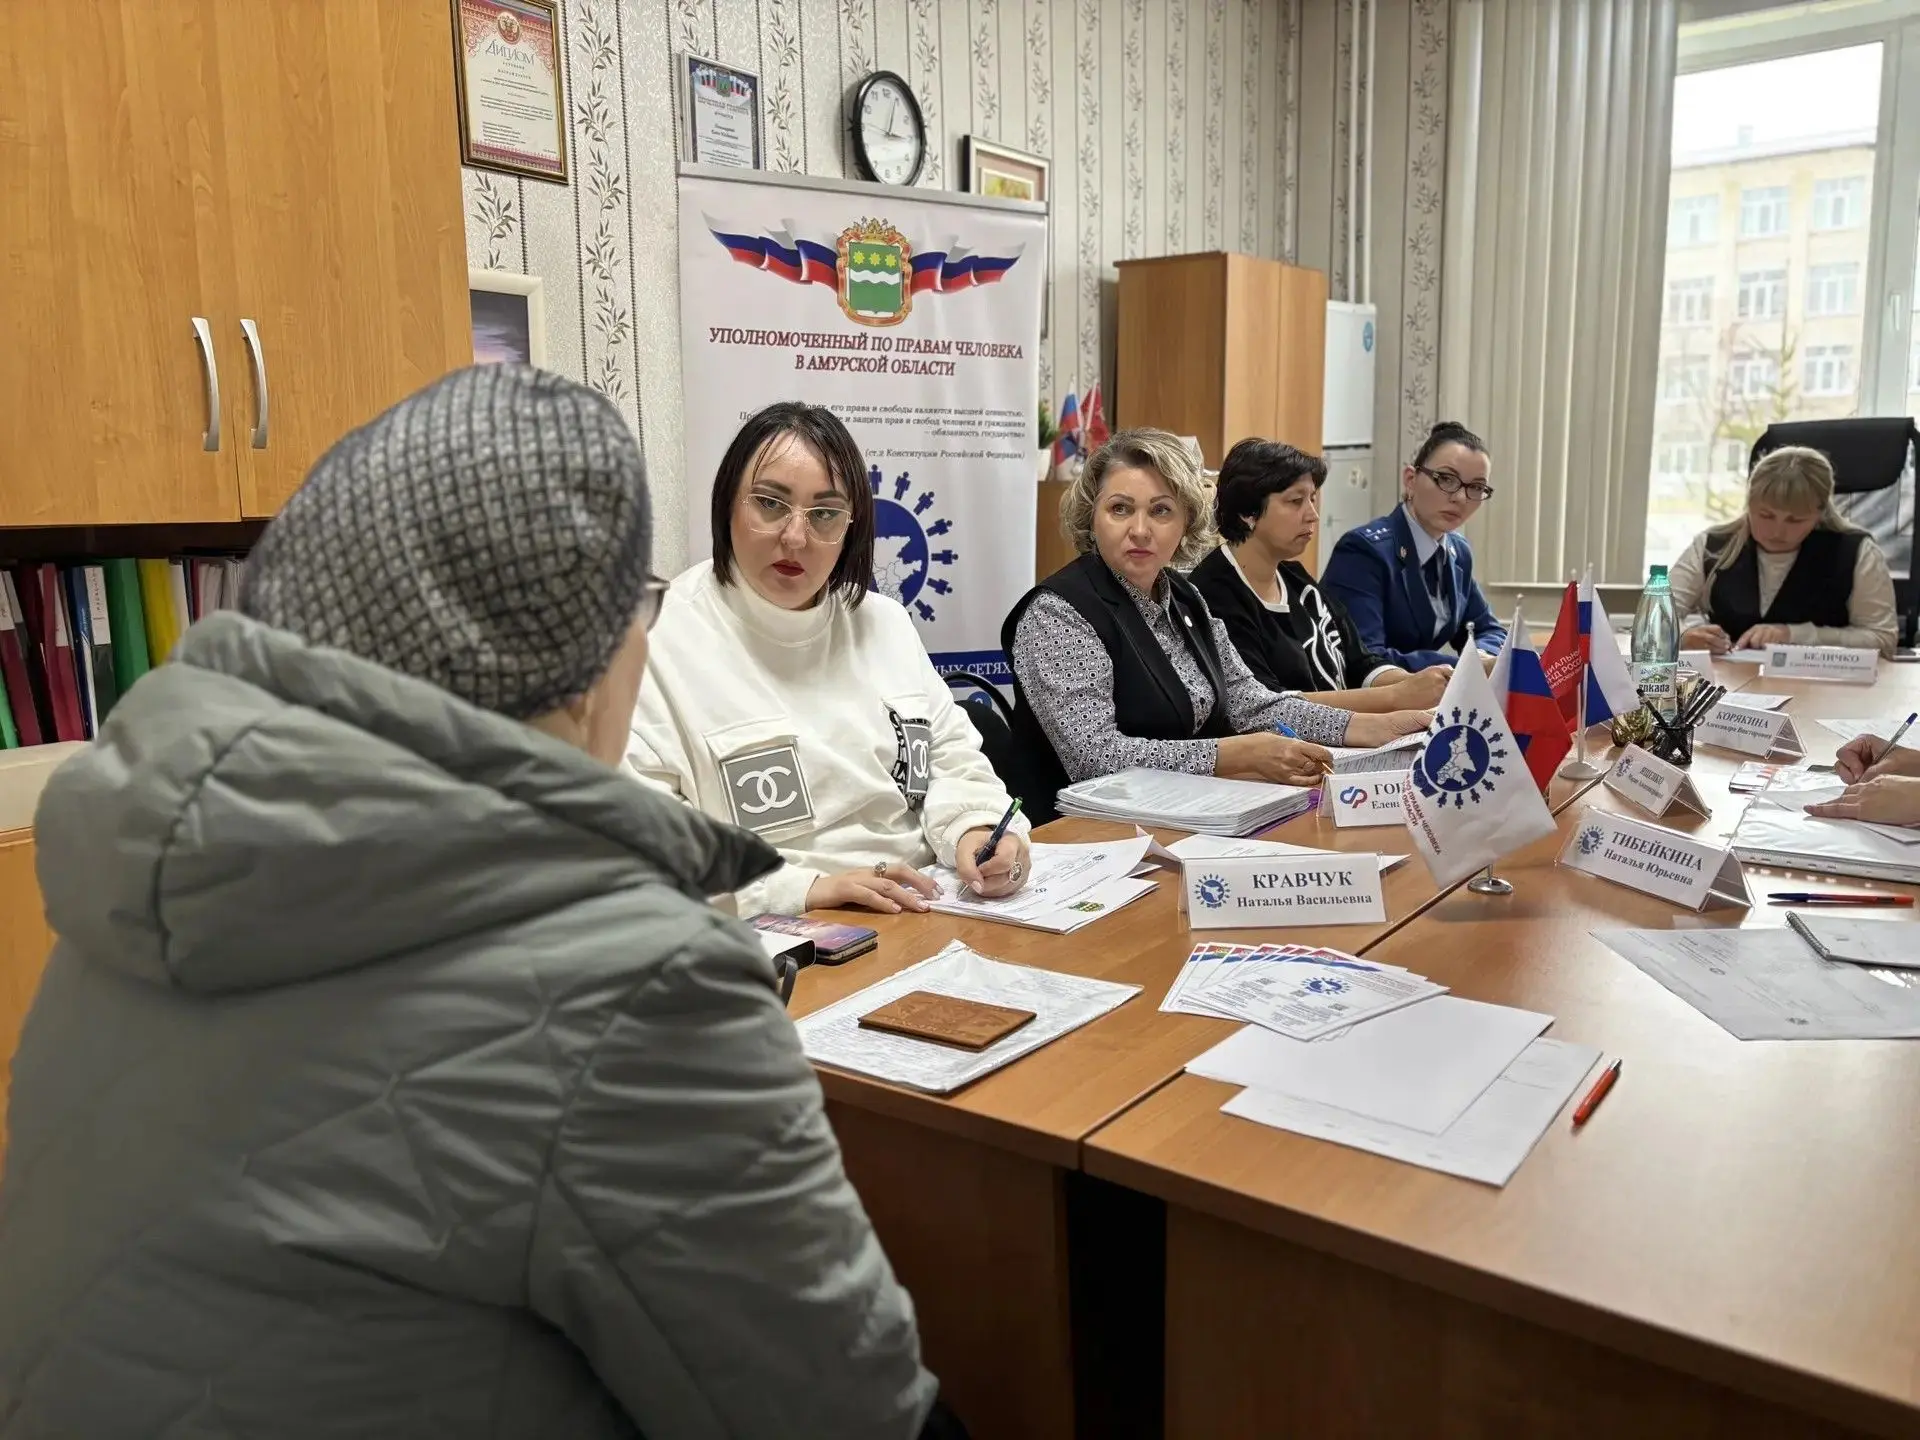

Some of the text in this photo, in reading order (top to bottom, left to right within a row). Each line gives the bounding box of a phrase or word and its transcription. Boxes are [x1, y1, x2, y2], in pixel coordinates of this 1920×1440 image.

[882, 87, 891, 98] 12
[709, 327, 1024, 359] УПОЛНОМОЧЕННЫЙ ПО ПРАВАМ ЧЕЛОВЕКА
[795, 354, 956, 377] В АМУРСКОЙ ОБЛАСТИ
[831, 404, 844, 413] его
[845, 404, 870, 414] права
[880, 405, 913, 414] свободы
[967, 661, 1012, 675] СЕТЯХ
[1716, 711, 1768, 729] КОРЯКИНА
[1422, 820, 1442, 855] ЧЕЛОВЕКА
[1611, 831, 1703, 871] ТИБЕЙКИНА
[1603, 848, 1693, 886] Наталья Юрьевна
[1253, 871, 1352, 889] КРАВЧУК
[1237, 894, 1372, 908] Наталья Васильевна
